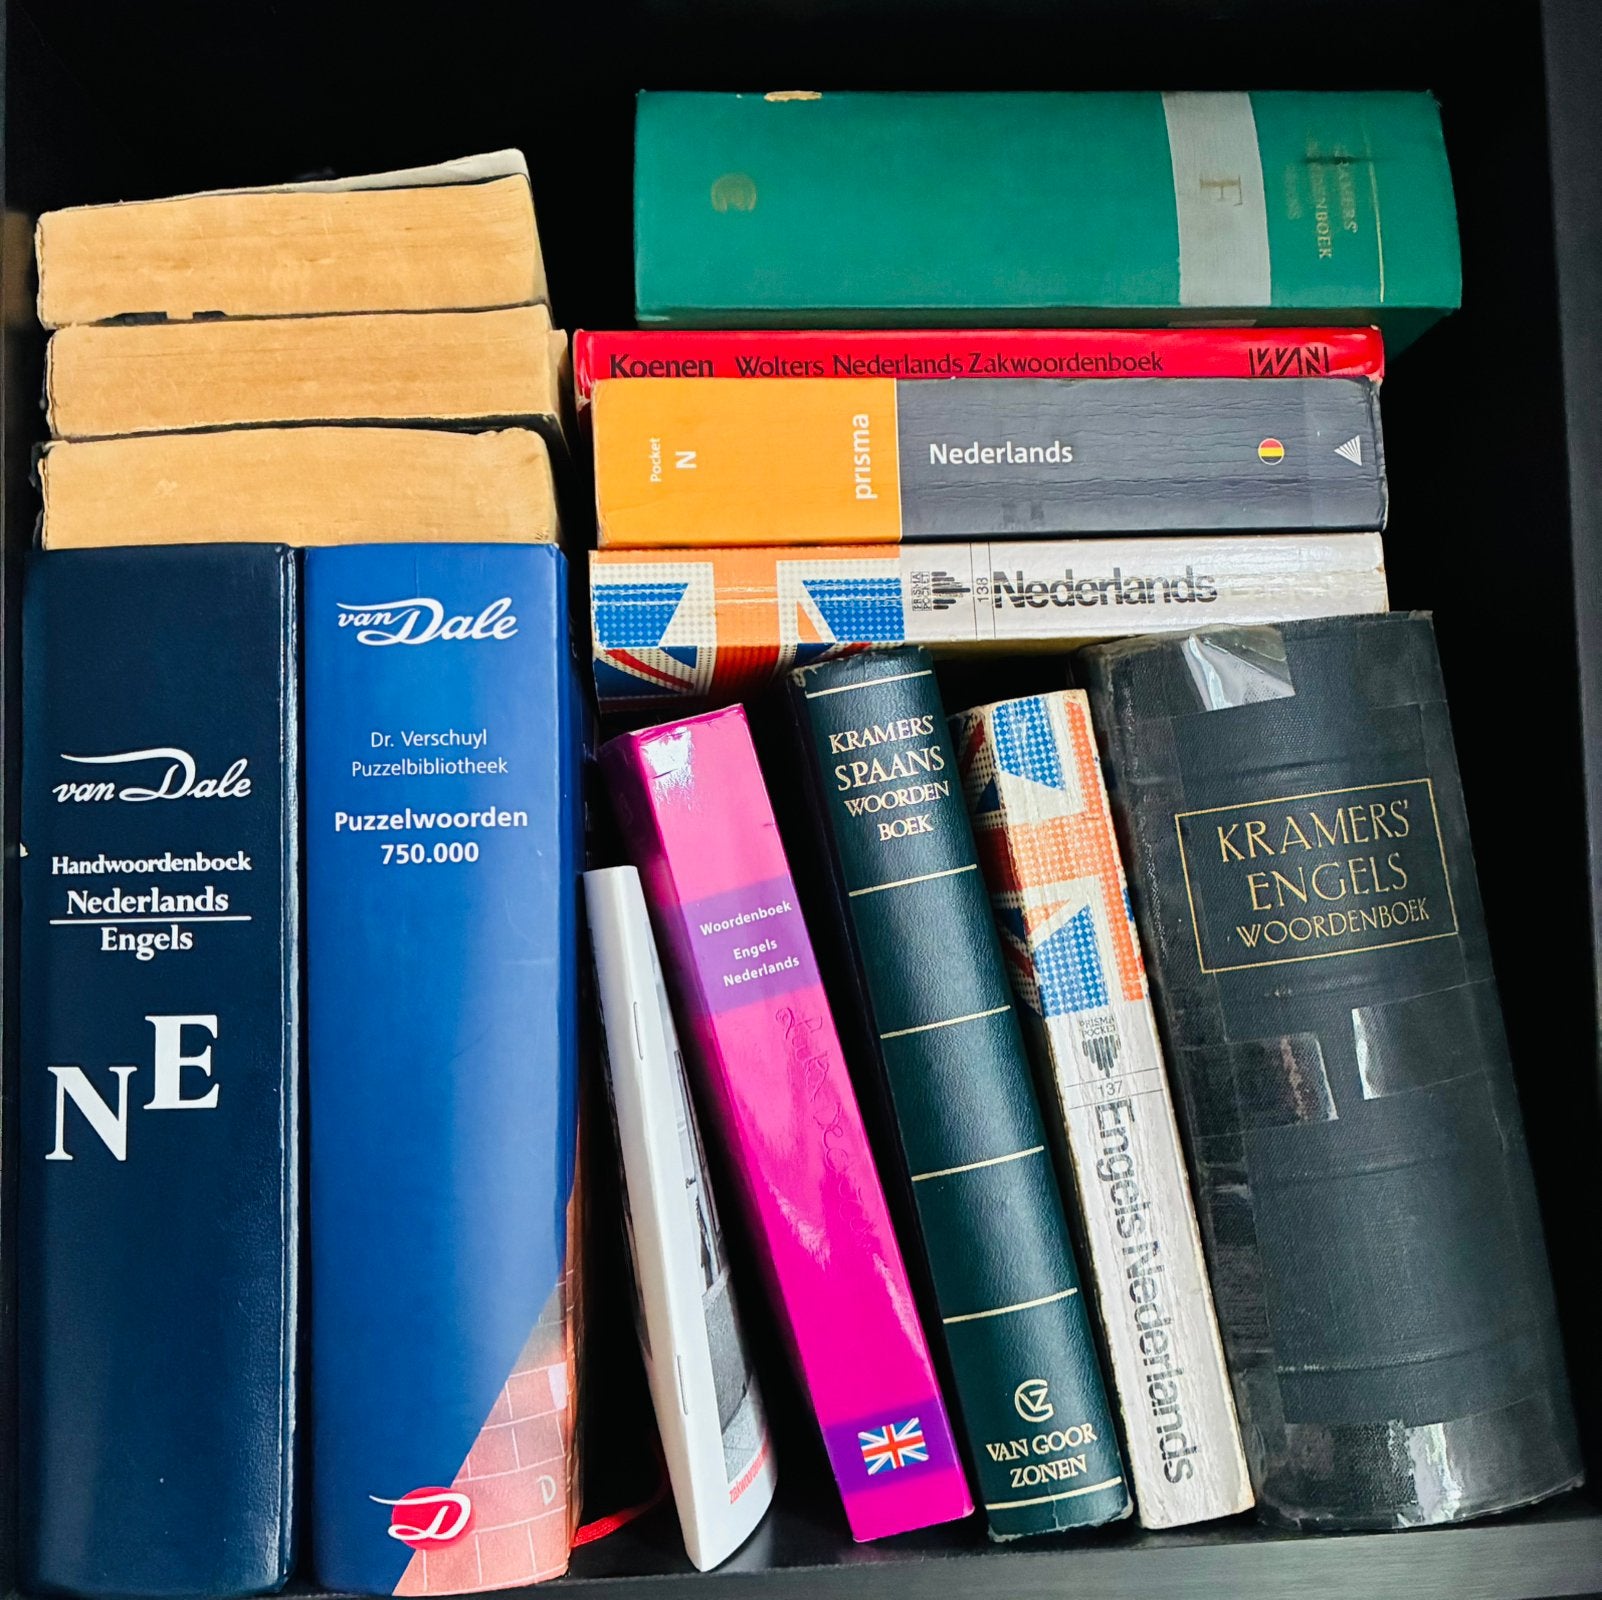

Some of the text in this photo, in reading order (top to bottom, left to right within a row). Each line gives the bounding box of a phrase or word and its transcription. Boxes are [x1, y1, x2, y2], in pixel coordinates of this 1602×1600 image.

[610, 352, 1164, 377] Koenen Wolters Nederlands Zakwoordenboek
[650, 437, 661, 483] Pocket
[675, 450, 697, 469] N
[852, 413, 877, 500] prisma
[929, 441, 1073, 465] Nederlands
[976, 577, 990, 602] 138
[993, 566, 1218, 609] Nederlands
[337, 597, 519, 646] van Dale
[370, 728, 488, 750] Dr. Verschuyl
[829, 715, 934, 754] KRAMERS
[52, 747, 252, 803] van Dale
[351, 757, 508, 778] Puzzelbibliotheek
[834, 745, 945, 791] SPAANS
[843, 780, 949, 817] WOORDEN
[334, 807, 528, 832] Puzzelwoorden
[878, 814, 933, 841] BOEK
[1217, 799, 1410, 863] KRAMERS'
[51, 851, 252, 875] Handwoordenboek
[380, 842, 480, 865] 750.000
[66, 886, 229, 914] Nederlands
[1247, 852, 1408, 912] ENGELS
[700, 900, 792, 936] Woordenboek
[1235, 897, 1430, 949] WOORDENBOEK
[100, 923, 194, 961] Engels
[732, 938, 778, 961] Engels
[723, 955, 800, 987] Nederlands
[1097, 1080, 1122, 1097] 137
[1095, 1098, 1146, 1240] Engels
[1121, 1243, 1196, 1484] Nederlands
[986, 1422, 1098, 1461] VAN GOOR
[1009, 1454, 1087, 1488] ZONEN
